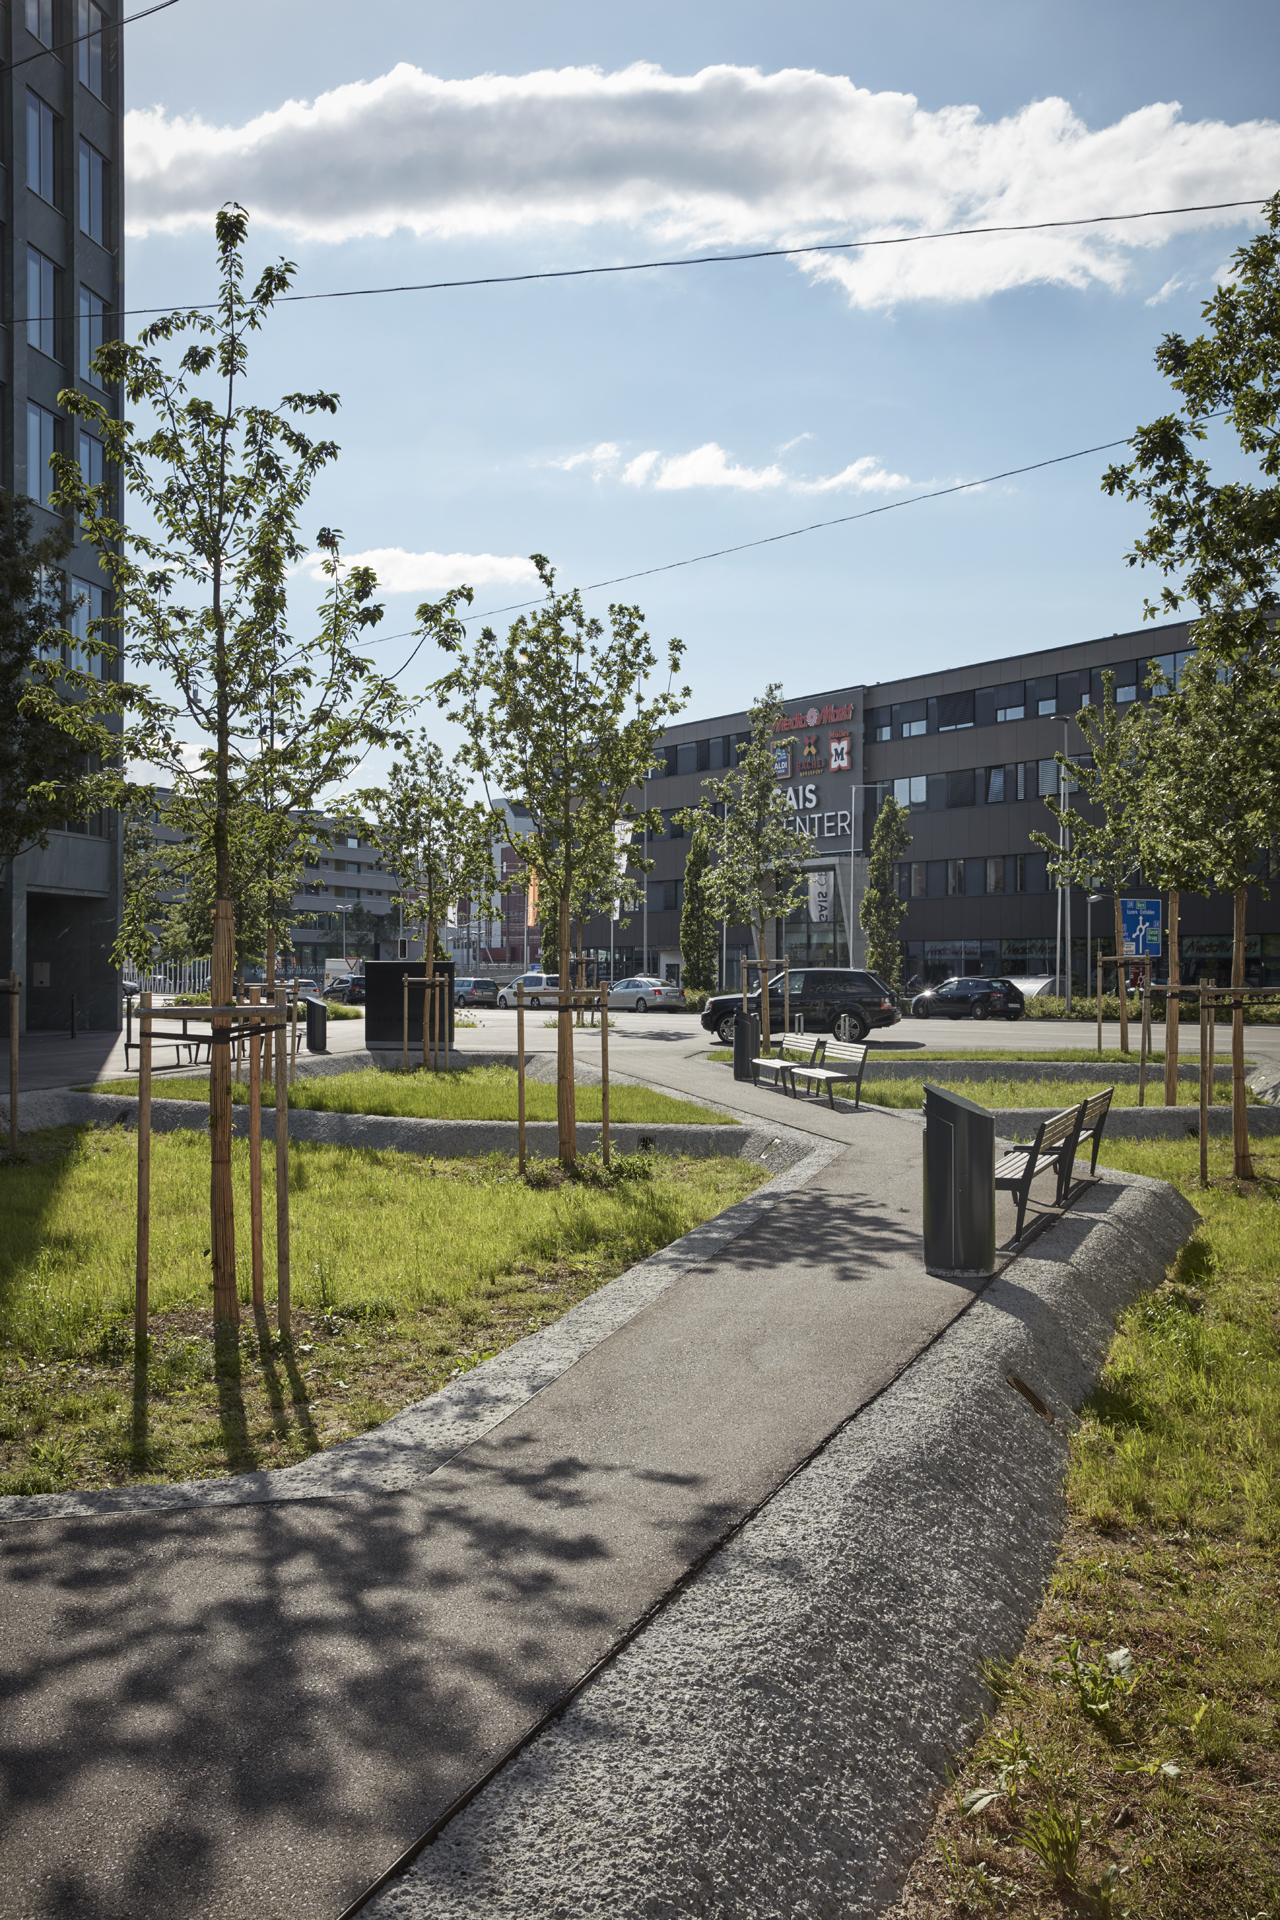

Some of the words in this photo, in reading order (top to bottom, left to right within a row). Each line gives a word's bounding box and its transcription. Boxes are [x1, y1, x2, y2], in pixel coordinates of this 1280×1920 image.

[816, 703, 854, 725] Markt
[829, 730, 849, 738] Müller
[834, 747, 844, 762] M
[774, 761, 787, 770] ALDI
[771, 811, 851, 838] ENTER
